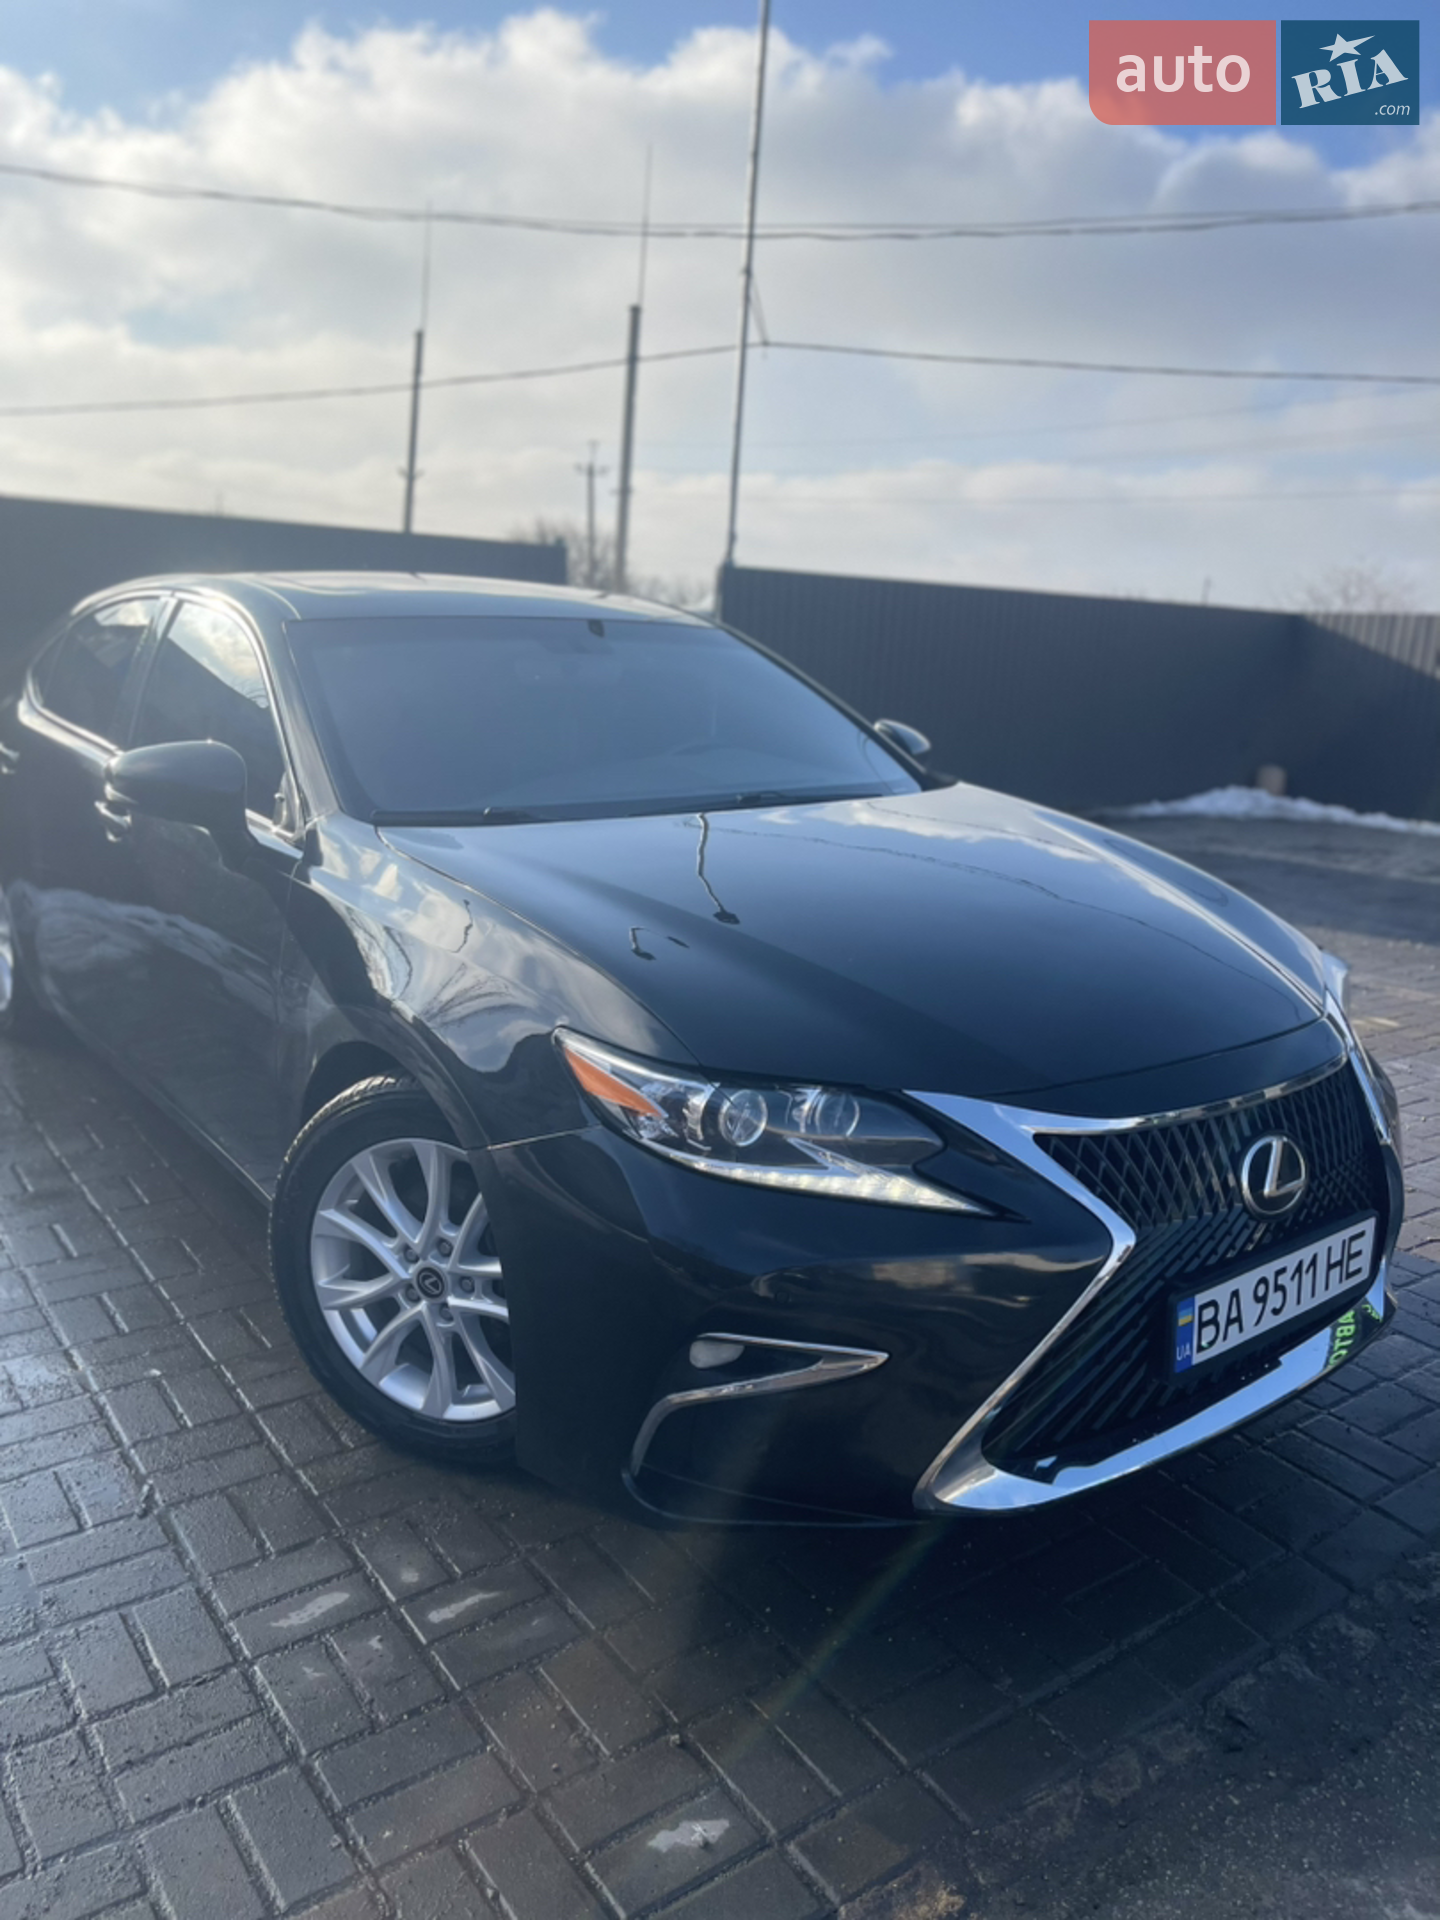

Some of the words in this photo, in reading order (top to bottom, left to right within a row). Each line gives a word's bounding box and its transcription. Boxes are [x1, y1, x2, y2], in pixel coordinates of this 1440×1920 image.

[1196, 1288, 1244, 1354] BA
[1252, 1252, 1318, 1327] 9511
[1324, 1229, 1366, 1291] HE
[1176, 1342, 1192, 1361] UA
